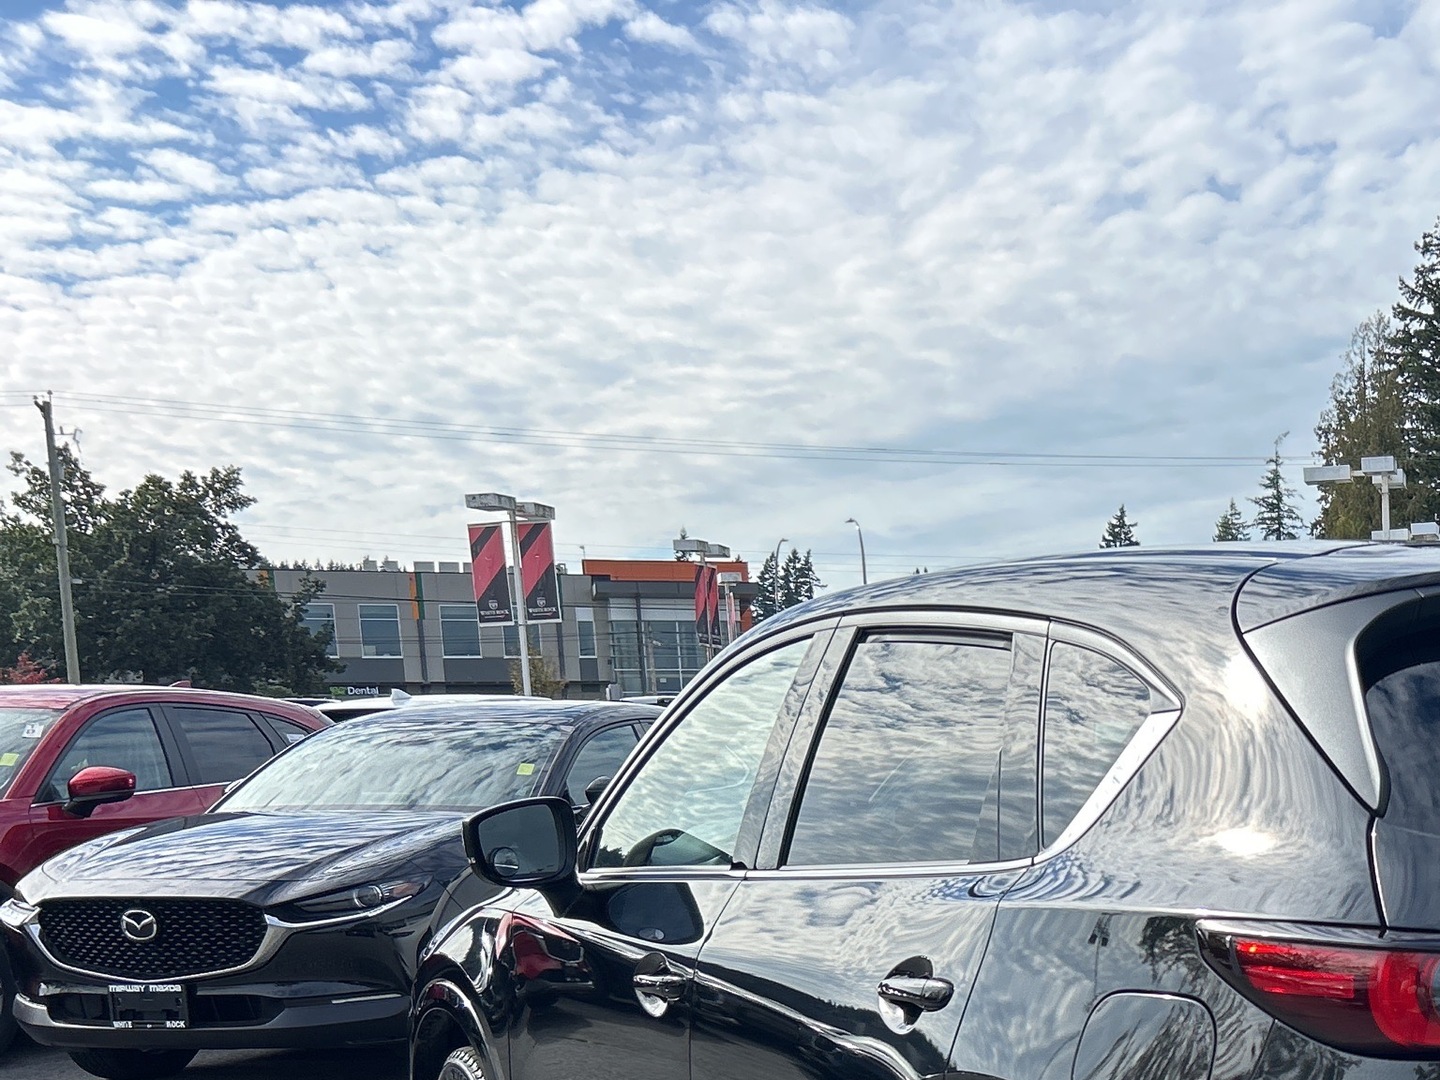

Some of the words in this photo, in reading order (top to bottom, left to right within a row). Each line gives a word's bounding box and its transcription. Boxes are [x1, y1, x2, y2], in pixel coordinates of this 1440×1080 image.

[347, 686, 379, 695] Dental
[113, 1020, 133, 1028] WHITE
[166, 1020, 185, 1028] ROCK
